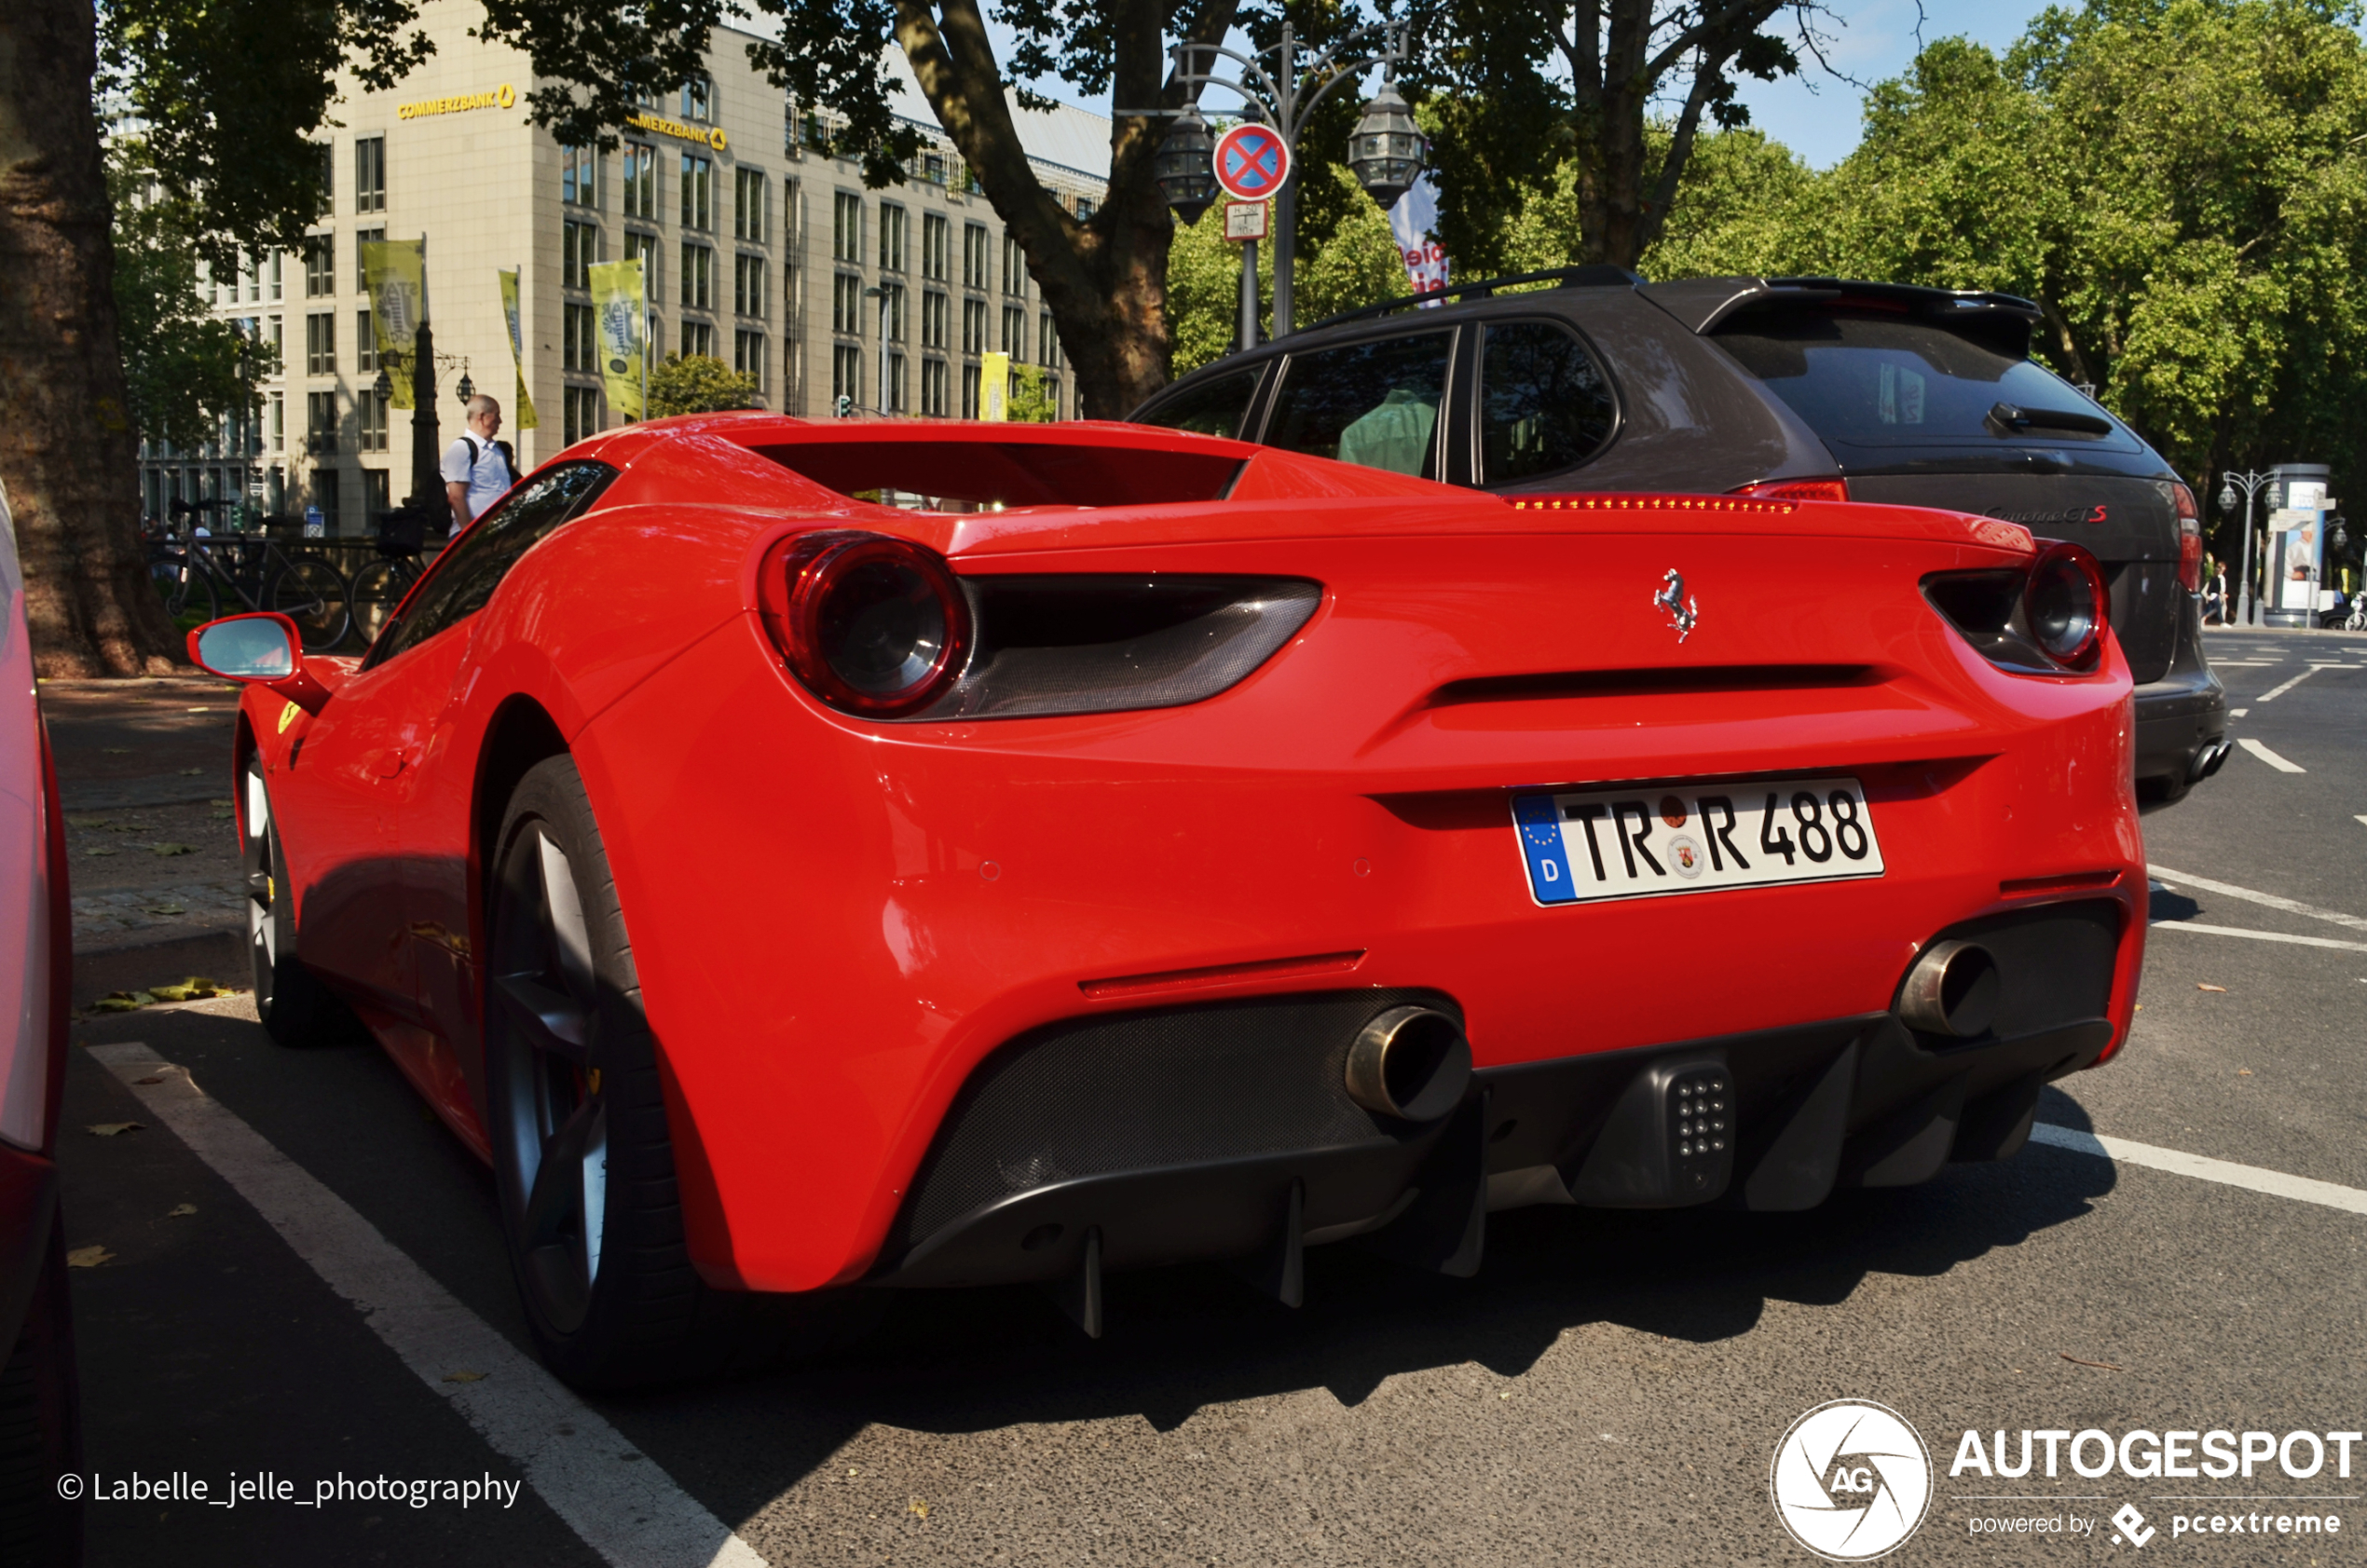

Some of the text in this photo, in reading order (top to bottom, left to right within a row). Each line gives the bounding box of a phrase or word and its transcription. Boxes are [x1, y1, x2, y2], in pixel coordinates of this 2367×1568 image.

[397, 91, 496, 119] COMMERZBANK
[625, 113, 708, 143] MERZBANK
[2063, 505, 2107, 524] GTS
[1562, 800, 1667, 881] TR
[1697, 796, 1751, 872] R
[1759, 790, 1869, 866] 488
[1541, 858, 1560, 882] D
